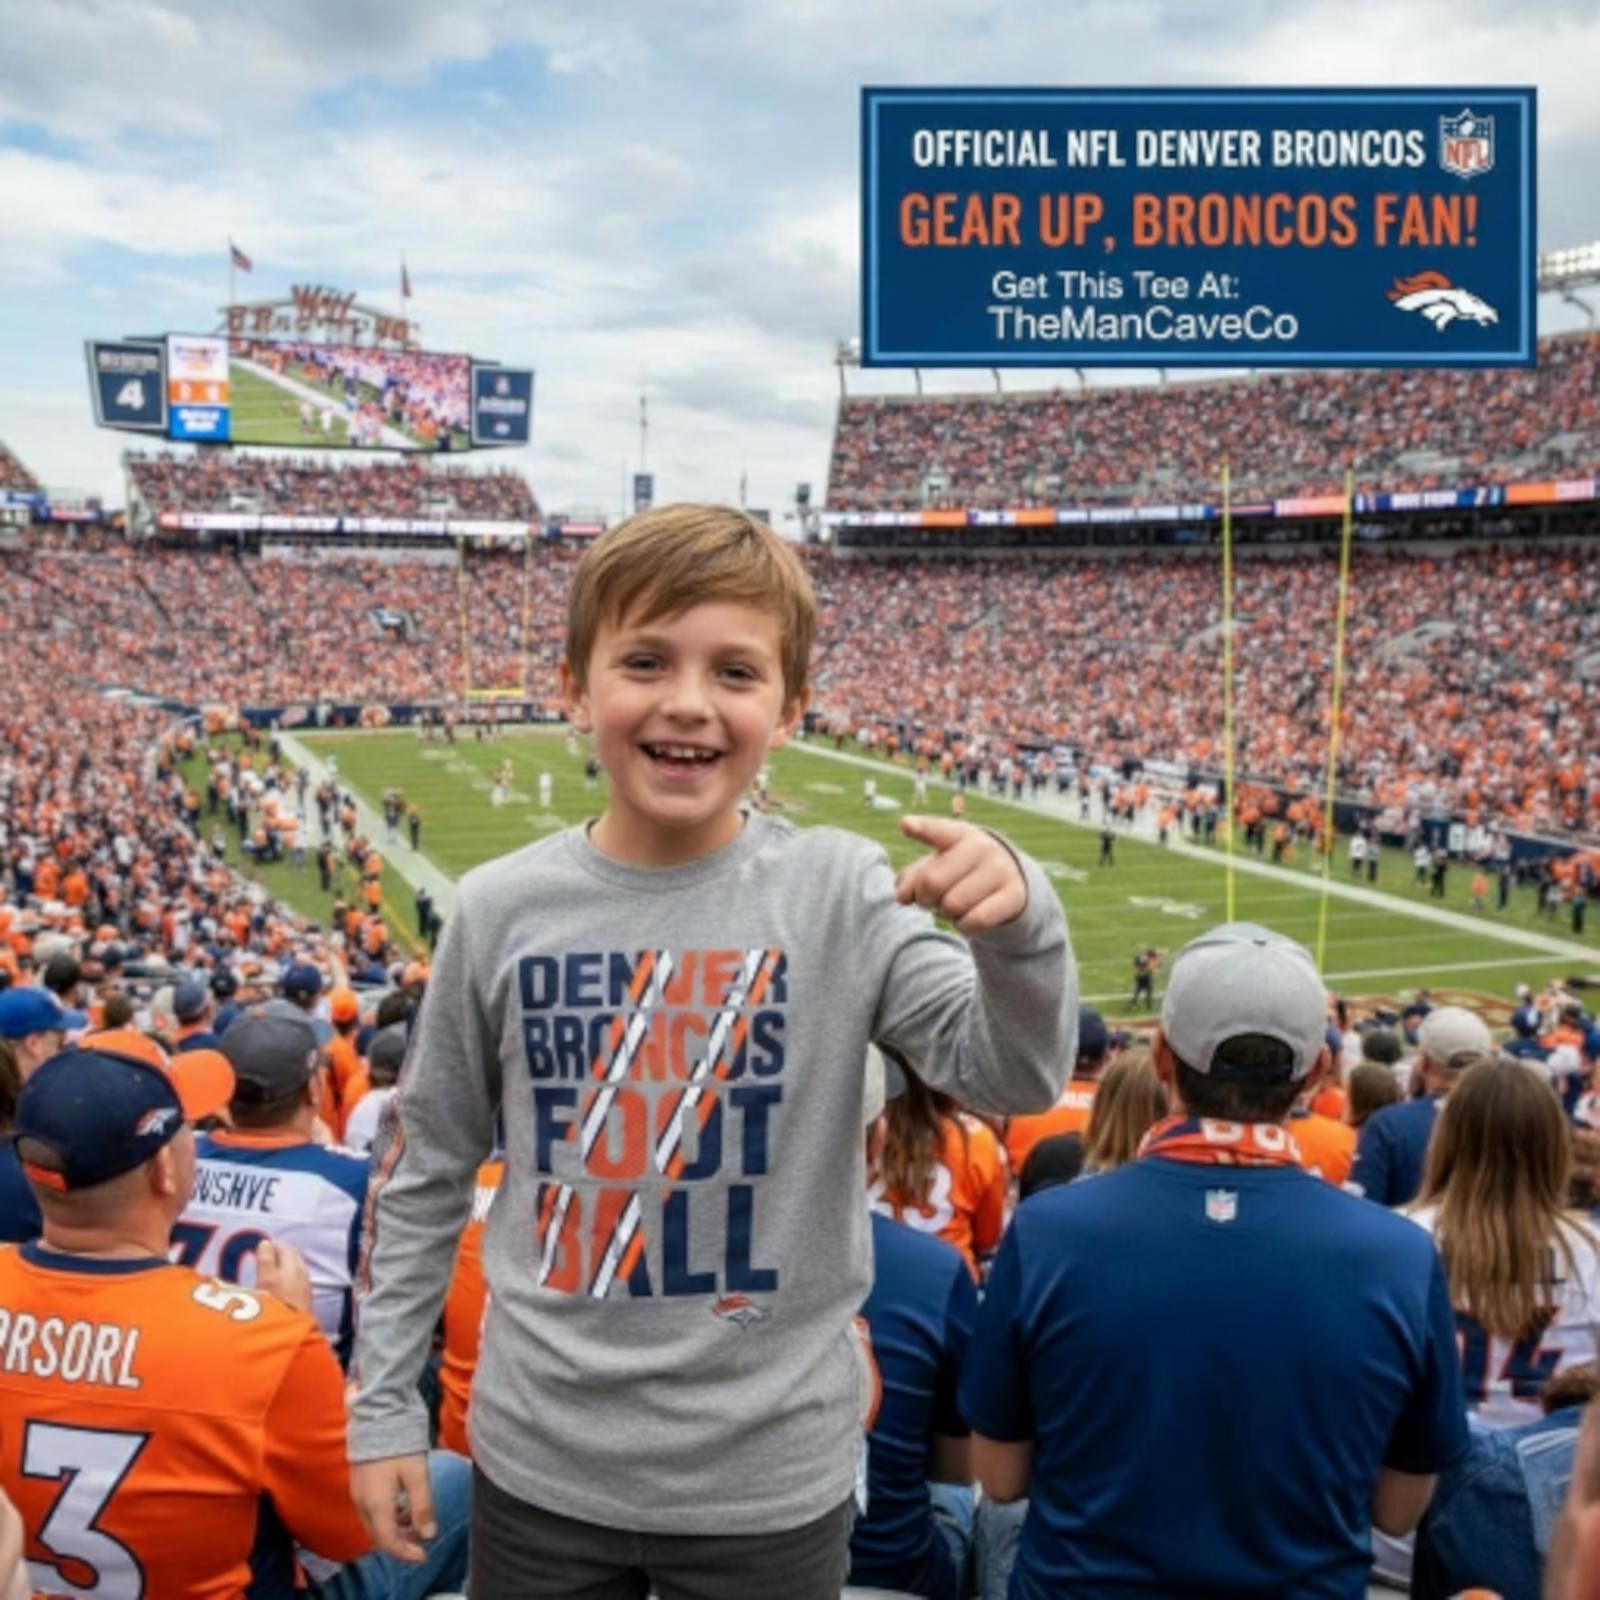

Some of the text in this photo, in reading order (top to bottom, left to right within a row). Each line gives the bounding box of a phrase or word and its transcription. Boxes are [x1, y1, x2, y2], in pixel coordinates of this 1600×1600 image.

[116, 379, 146, 410] 4
[518, 949, 788, 1011] DENVER
[522, 1010, 786, 1083] BRONCOS
[532, 1084, 783, 1181] FOOT
[535, 1182, 779, 1300] BALL
[21, 1420, 153, 1600] 3
